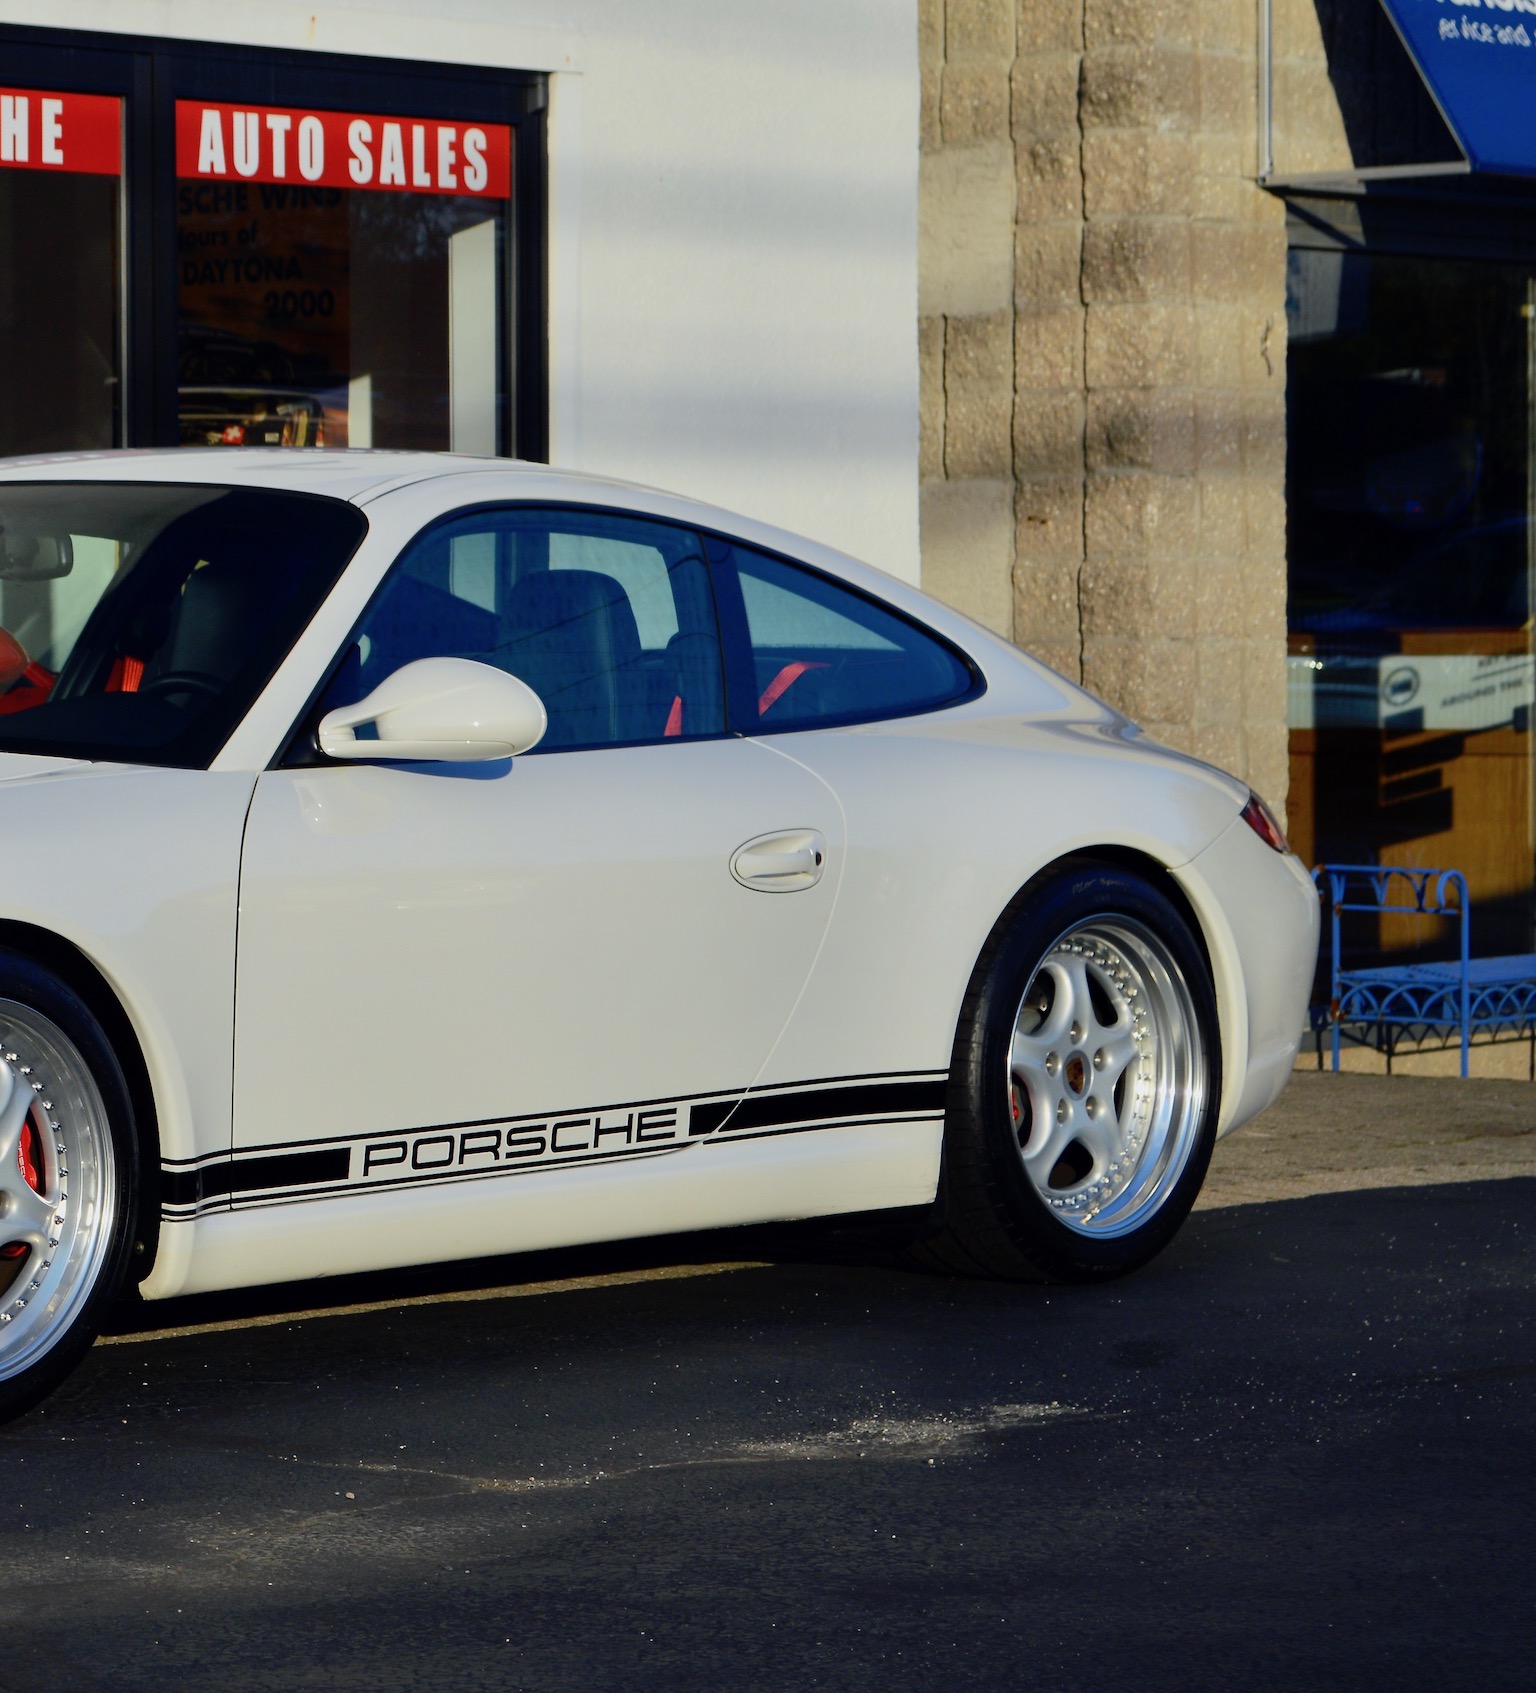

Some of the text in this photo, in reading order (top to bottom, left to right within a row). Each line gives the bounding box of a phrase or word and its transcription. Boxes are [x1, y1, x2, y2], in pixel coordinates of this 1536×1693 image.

[197, 108, 488, 192] AUTO SALES
[259, 183, 342, 210] WINS
[238, 220, 259, 244] of
[182, 256, 303, 286] DAYTONA
[265, 289, 335, 319] 2000
[362, 1106, 679, 1178] PORSCHE
